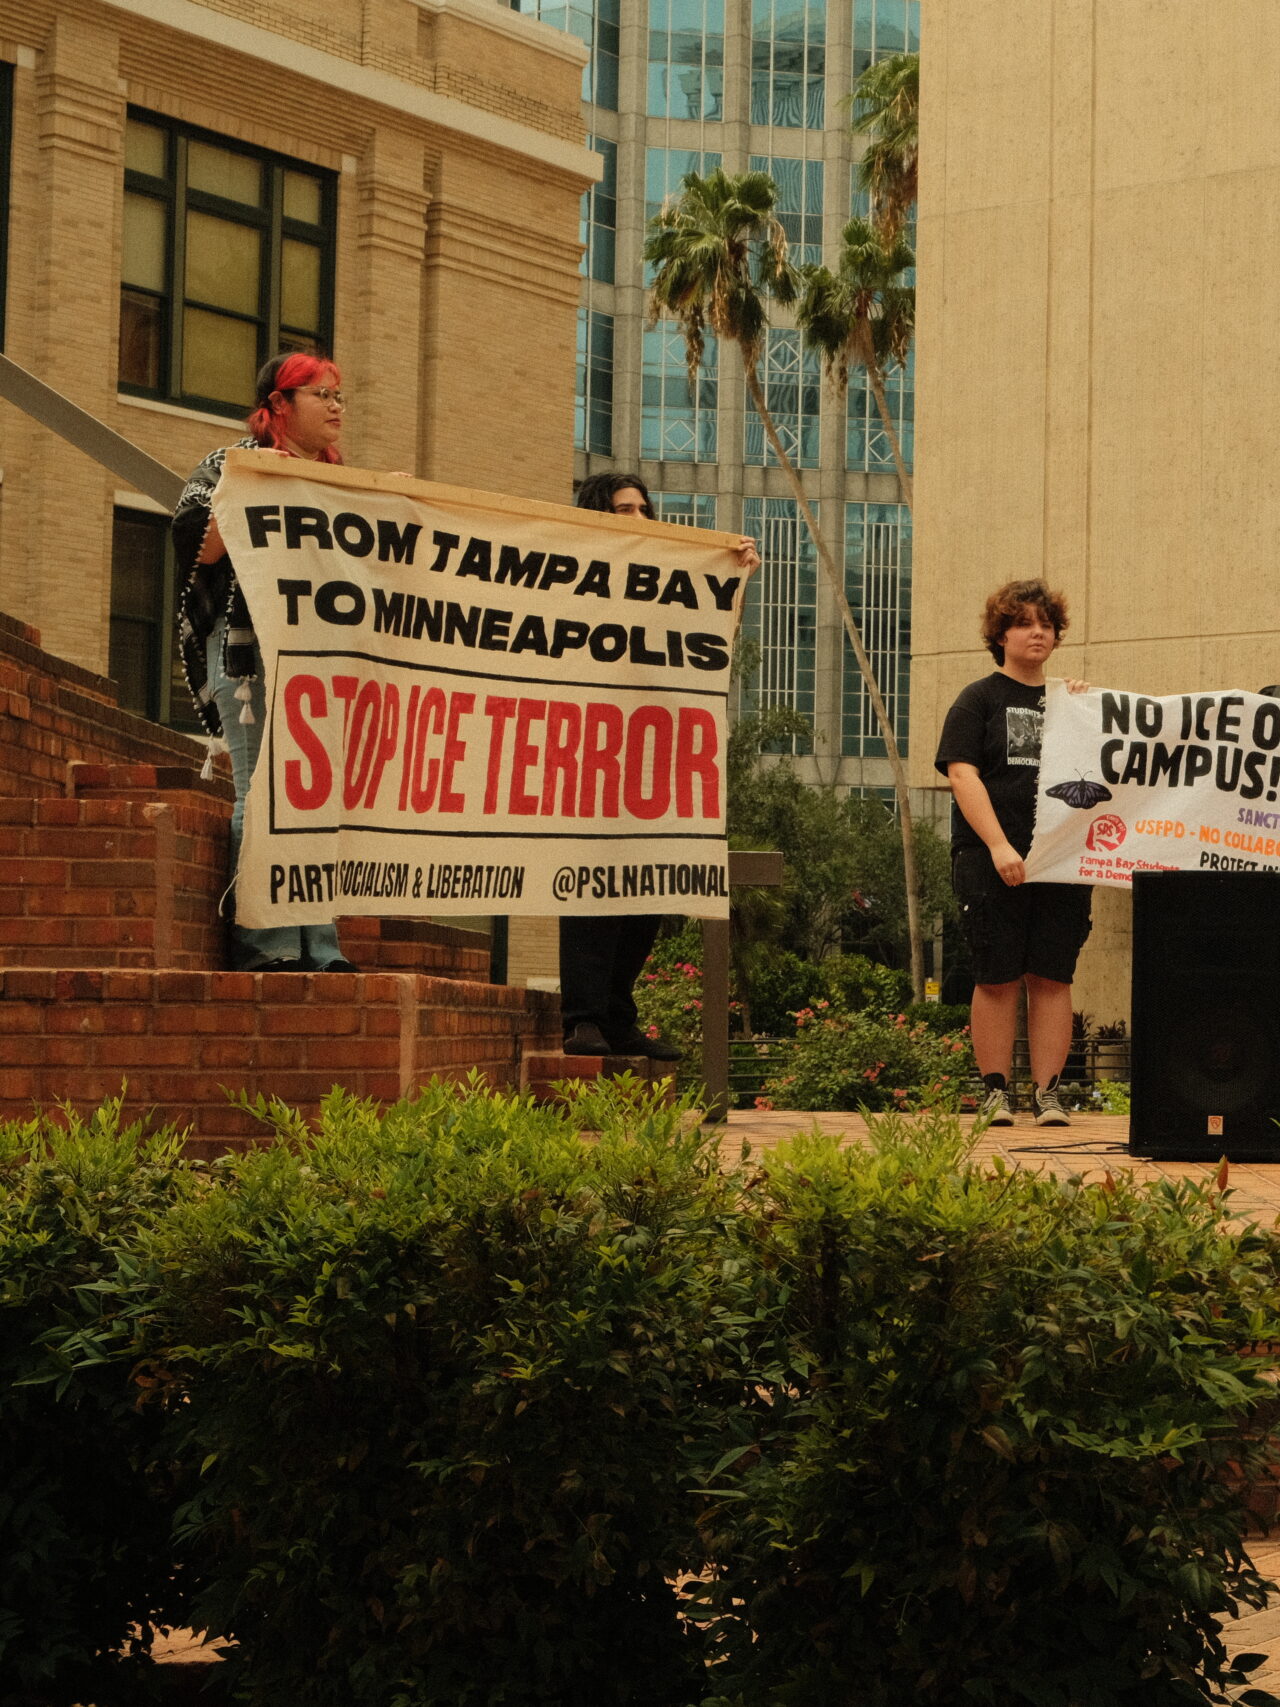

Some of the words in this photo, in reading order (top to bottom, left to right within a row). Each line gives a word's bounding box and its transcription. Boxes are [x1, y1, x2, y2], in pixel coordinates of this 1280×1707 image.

[244, 505, 422, 566] FROM
[430, 531, 610, 599] TAMPA
[624, 563, 740, 612] BAY
[277, 578, 366, 627] TO
[374, 588, 729, 672] MINNEAPOLIS
[1100, 692, 1163, 738] NO
[1180, 696, 1244, 743] ICE
[284, 673, 399, 812] STOP
[398, 684, 476, 815] ICE
[482, 697, 720, 820] TERROR
[1134, 819, 1185, 840] USFPD
[1199, 825, 1221, 845] NO
[338, 860, 410, 898] SOCIALISM
[412, 866, 423, 898] &
[426, 863, 525, 899] LIBERATION
[552, 862, 729, 902] @PSLNATIONAL
[1079, 866, 1095, 877] for
[1096, 869, 1103, 879] a
[1080, 856, 1113, 868] Tampa
[1116, 857, 1135, 870] Bay
[1200, 851, 1258, 872] PROTECT
